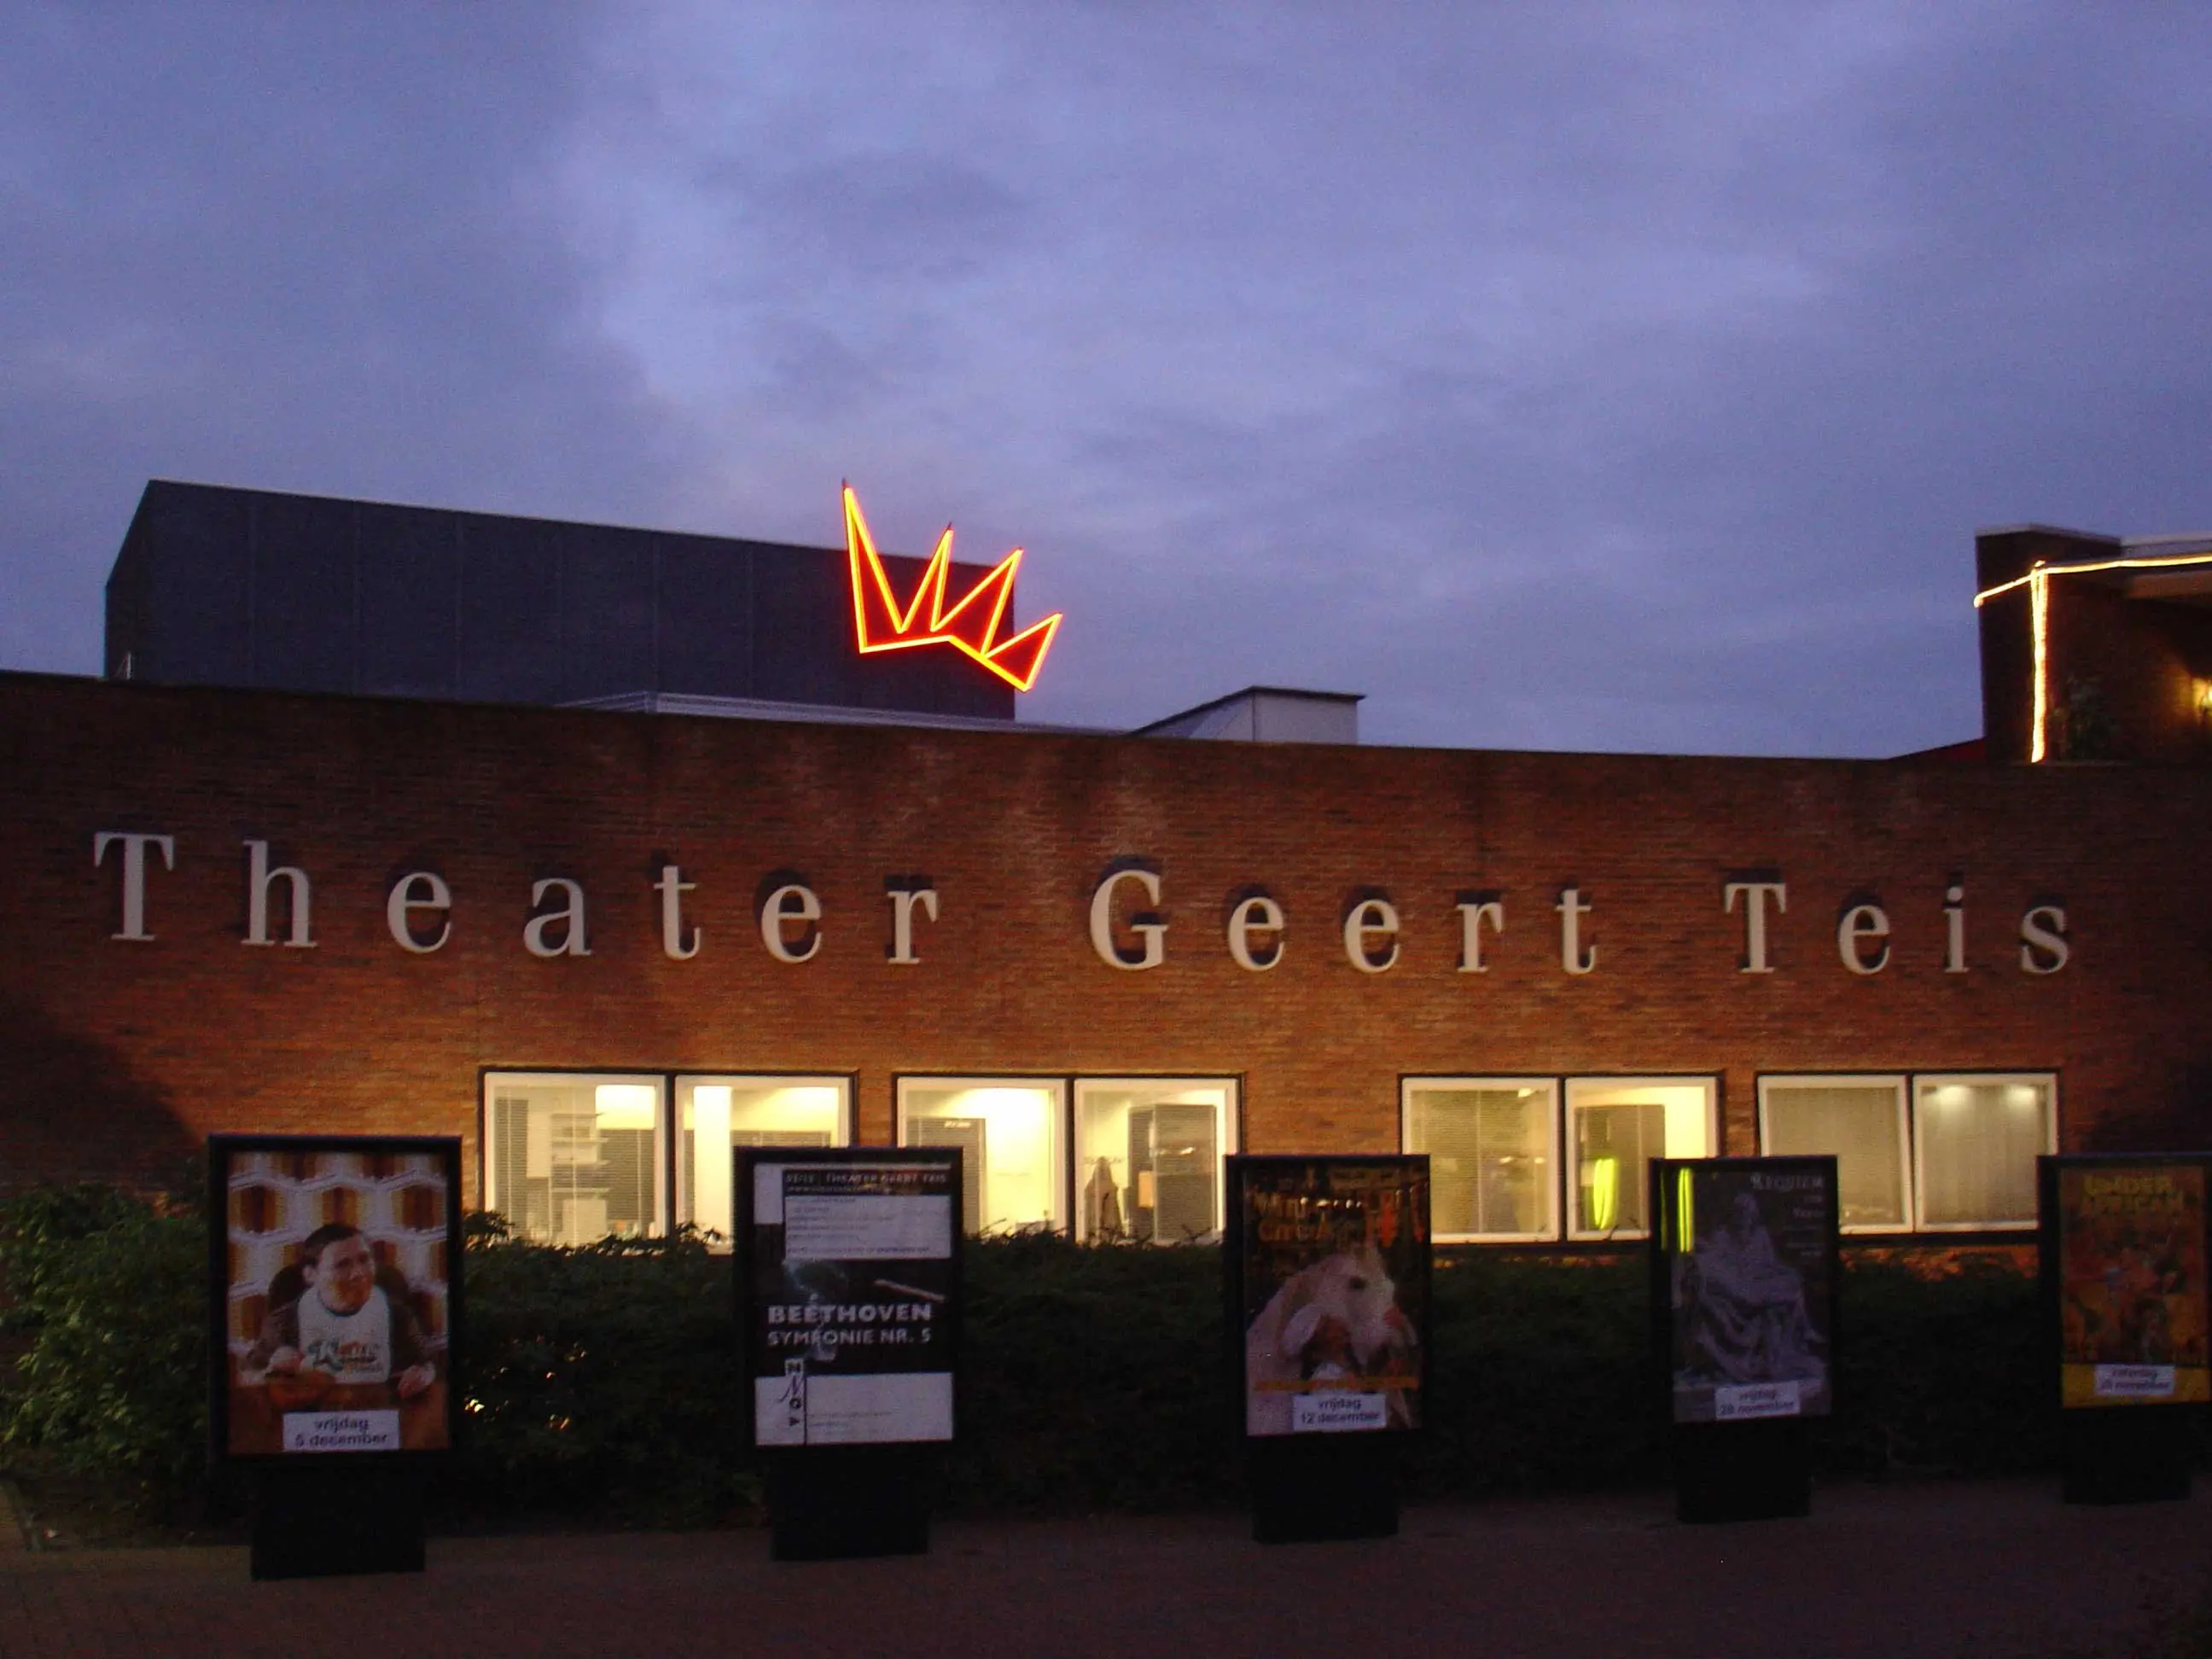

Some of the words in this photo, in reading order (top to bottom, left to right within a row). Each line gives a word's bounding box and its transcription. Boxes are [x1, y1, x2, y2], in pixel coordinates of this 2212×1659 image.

[94, 831, 938, 965] Theater
[1090, 870, 1597, 974] Geert
[1724, 882, 2069, 974] Teis
[769, 1303, 932, 1324] BEETHOVEN
[768, 1329, 875, 1346] SYMFONIE
[879, 1328, 915, 1344] NR.
[921, 1327, 932, 1343] 5
[314, 1417, 370, 1434] vrijdag
